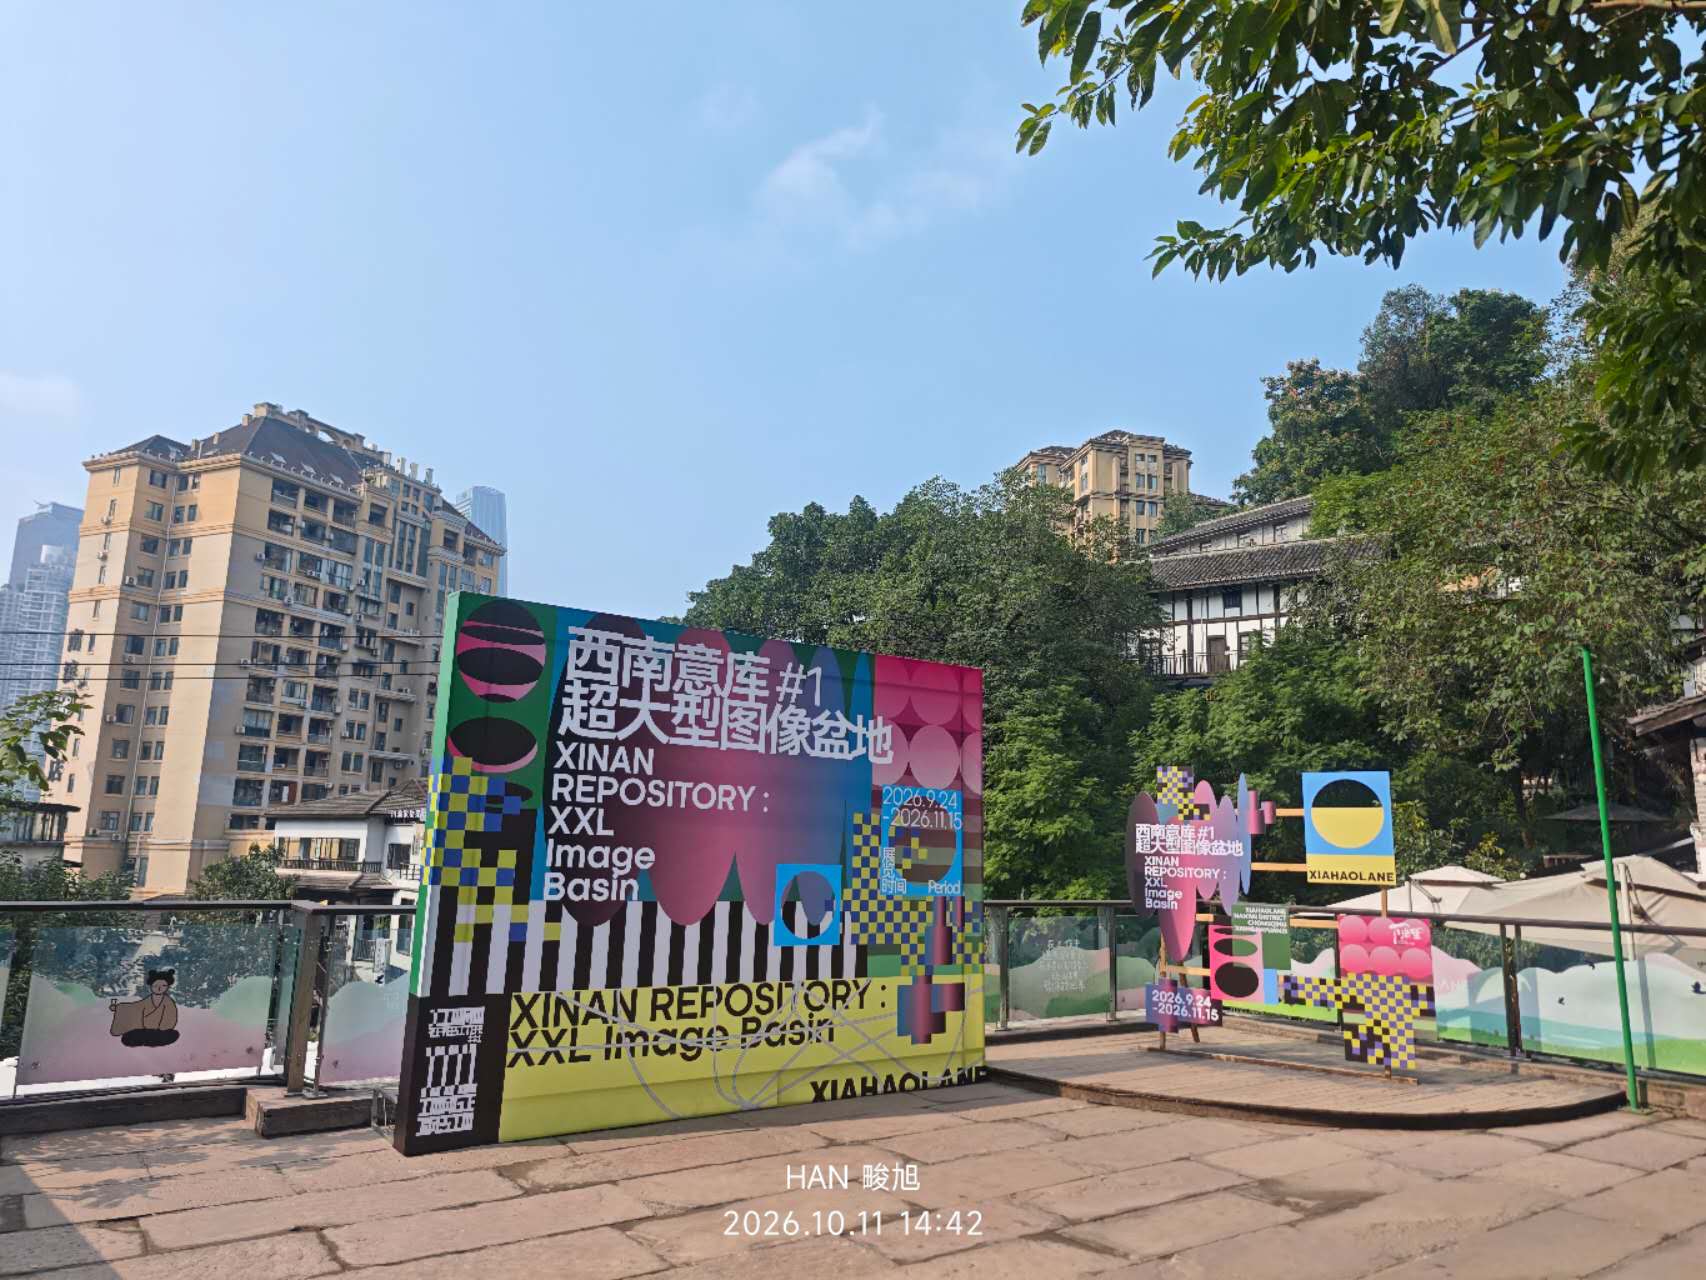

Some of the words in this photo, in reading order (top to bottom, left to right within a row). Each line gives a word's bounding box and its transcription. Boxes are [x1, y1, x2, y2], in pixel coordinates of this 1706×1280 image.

[567, 626, 770, 702] 西南意库
[776, 662, 822, 706] #1
[558, 679, 894, 764] 超大型图像盆地
[553, 741, 654, 775] XINAN
[883, 786, 957, 809] 2026.9.24
[548, 806, 614, 836] XXL
[1135, 823, 1196, 841] 西南意库
[1198, 826, 1215, 840] #1
[546, 838, 656, 878] Image
[1135, 838, 1244, 857] 超大型图像盆地
[1144, 856, 1179, 867] XINAN
[1144, 877, 1168, 887] XXL
[1309, 870, 1394, 882] XIAHAOLANE
[543, 872, 640, 902] Basin
[928, 880, 961, 894] Period
[1144, 888, 1183, 900] Image
[1145, 899, 1178, 910] Basin
[509, 988, 638, 1031] XINAN
[1152, 990, 1212, 1008] 2026.9.24
[507, 1027, 591, 1068] XXL
[604, 1022, 729, 1062] Image
[741, 1012, 834, 1049] Basin
